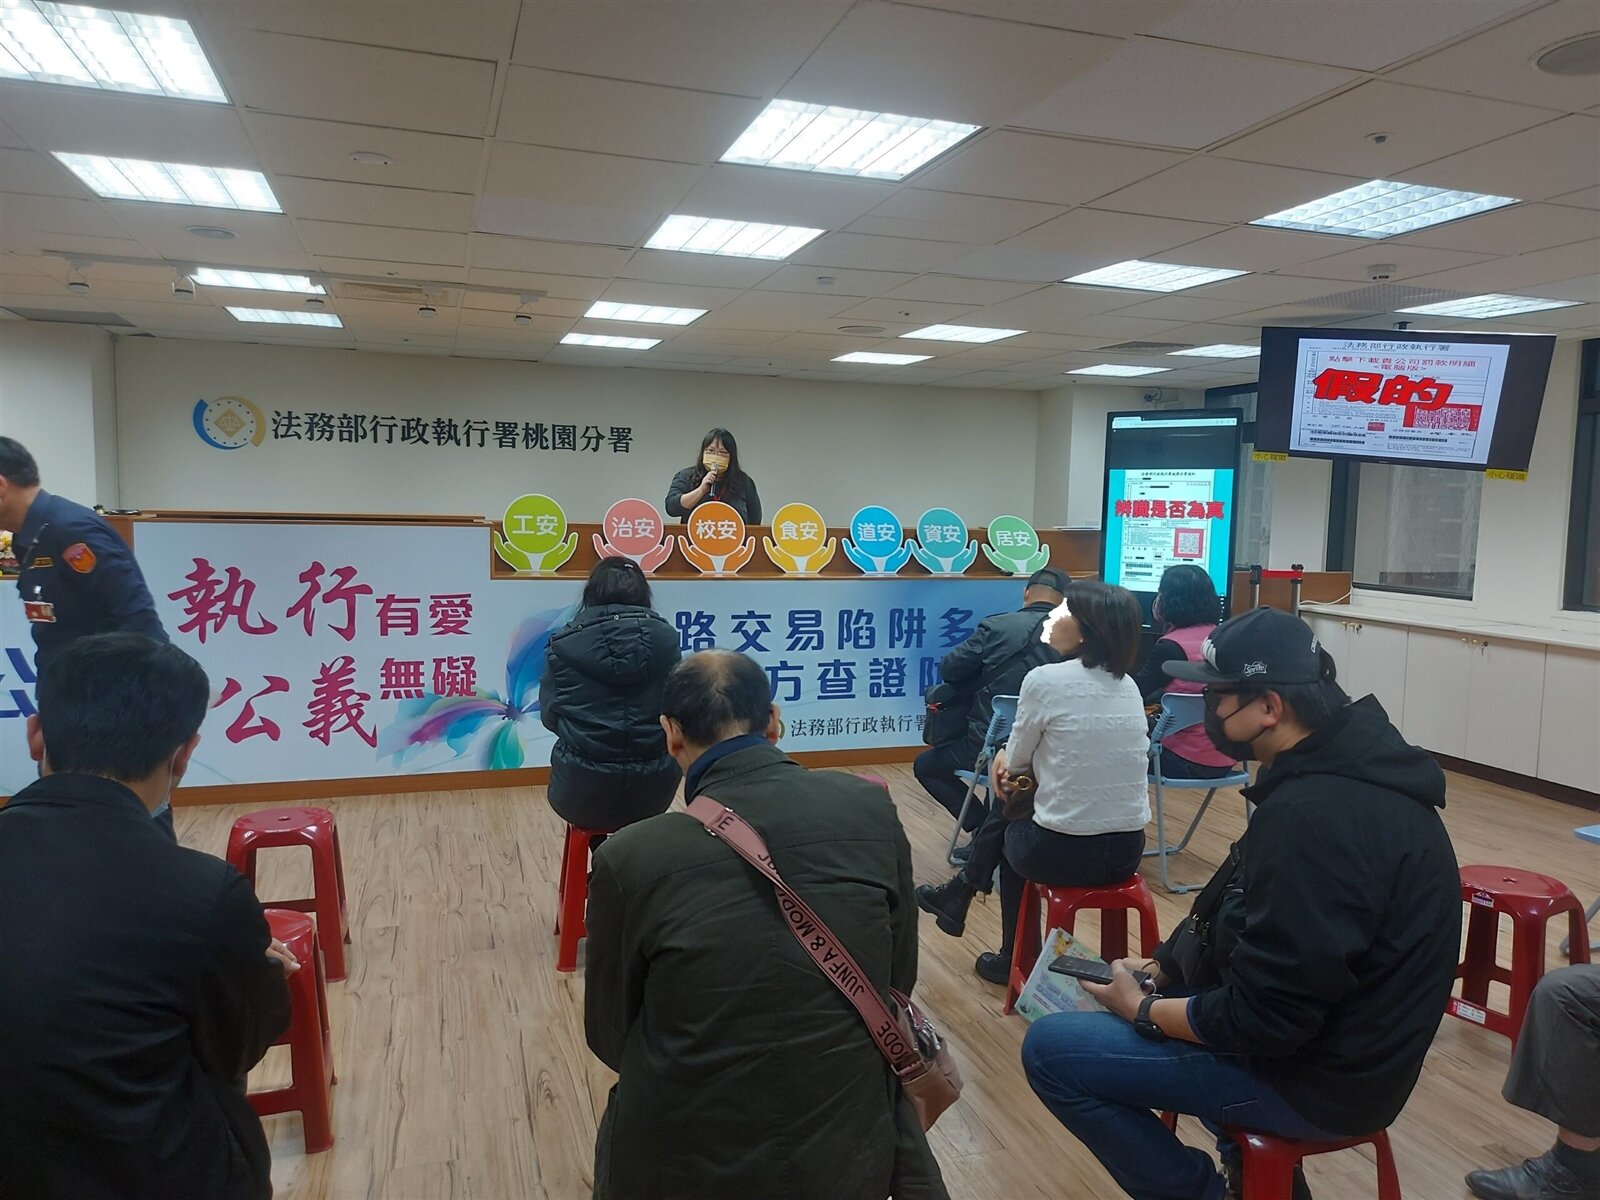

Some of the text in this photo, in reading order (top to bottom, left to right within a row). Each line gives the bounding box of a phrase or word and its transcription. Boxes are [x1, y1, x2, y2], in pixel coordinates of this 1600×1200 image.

[1312, 367, 1454, 411] 假的
[271, 410, 634, 453] 法務部行政執行署桃園分署
[1115, 500, 1224, 519] 辨識是否為真
[512, 514, 558, 536] 工安
[611, 516, 655, 538] 治安
[695, 519, 737, 540] 校安
[779, 521, 818, 541] 食安
[857, 522, 896, 542] 道安
[923, 524, 961, 543] 資安
[996, 530, 1031, 547] 居安
[168, 558, 473, 644] 執行有愛
[212, 655, 477, 748] 公義無礙
[810, 936, 826, 951] &
[823, 947, 864, 997] JUNFA
